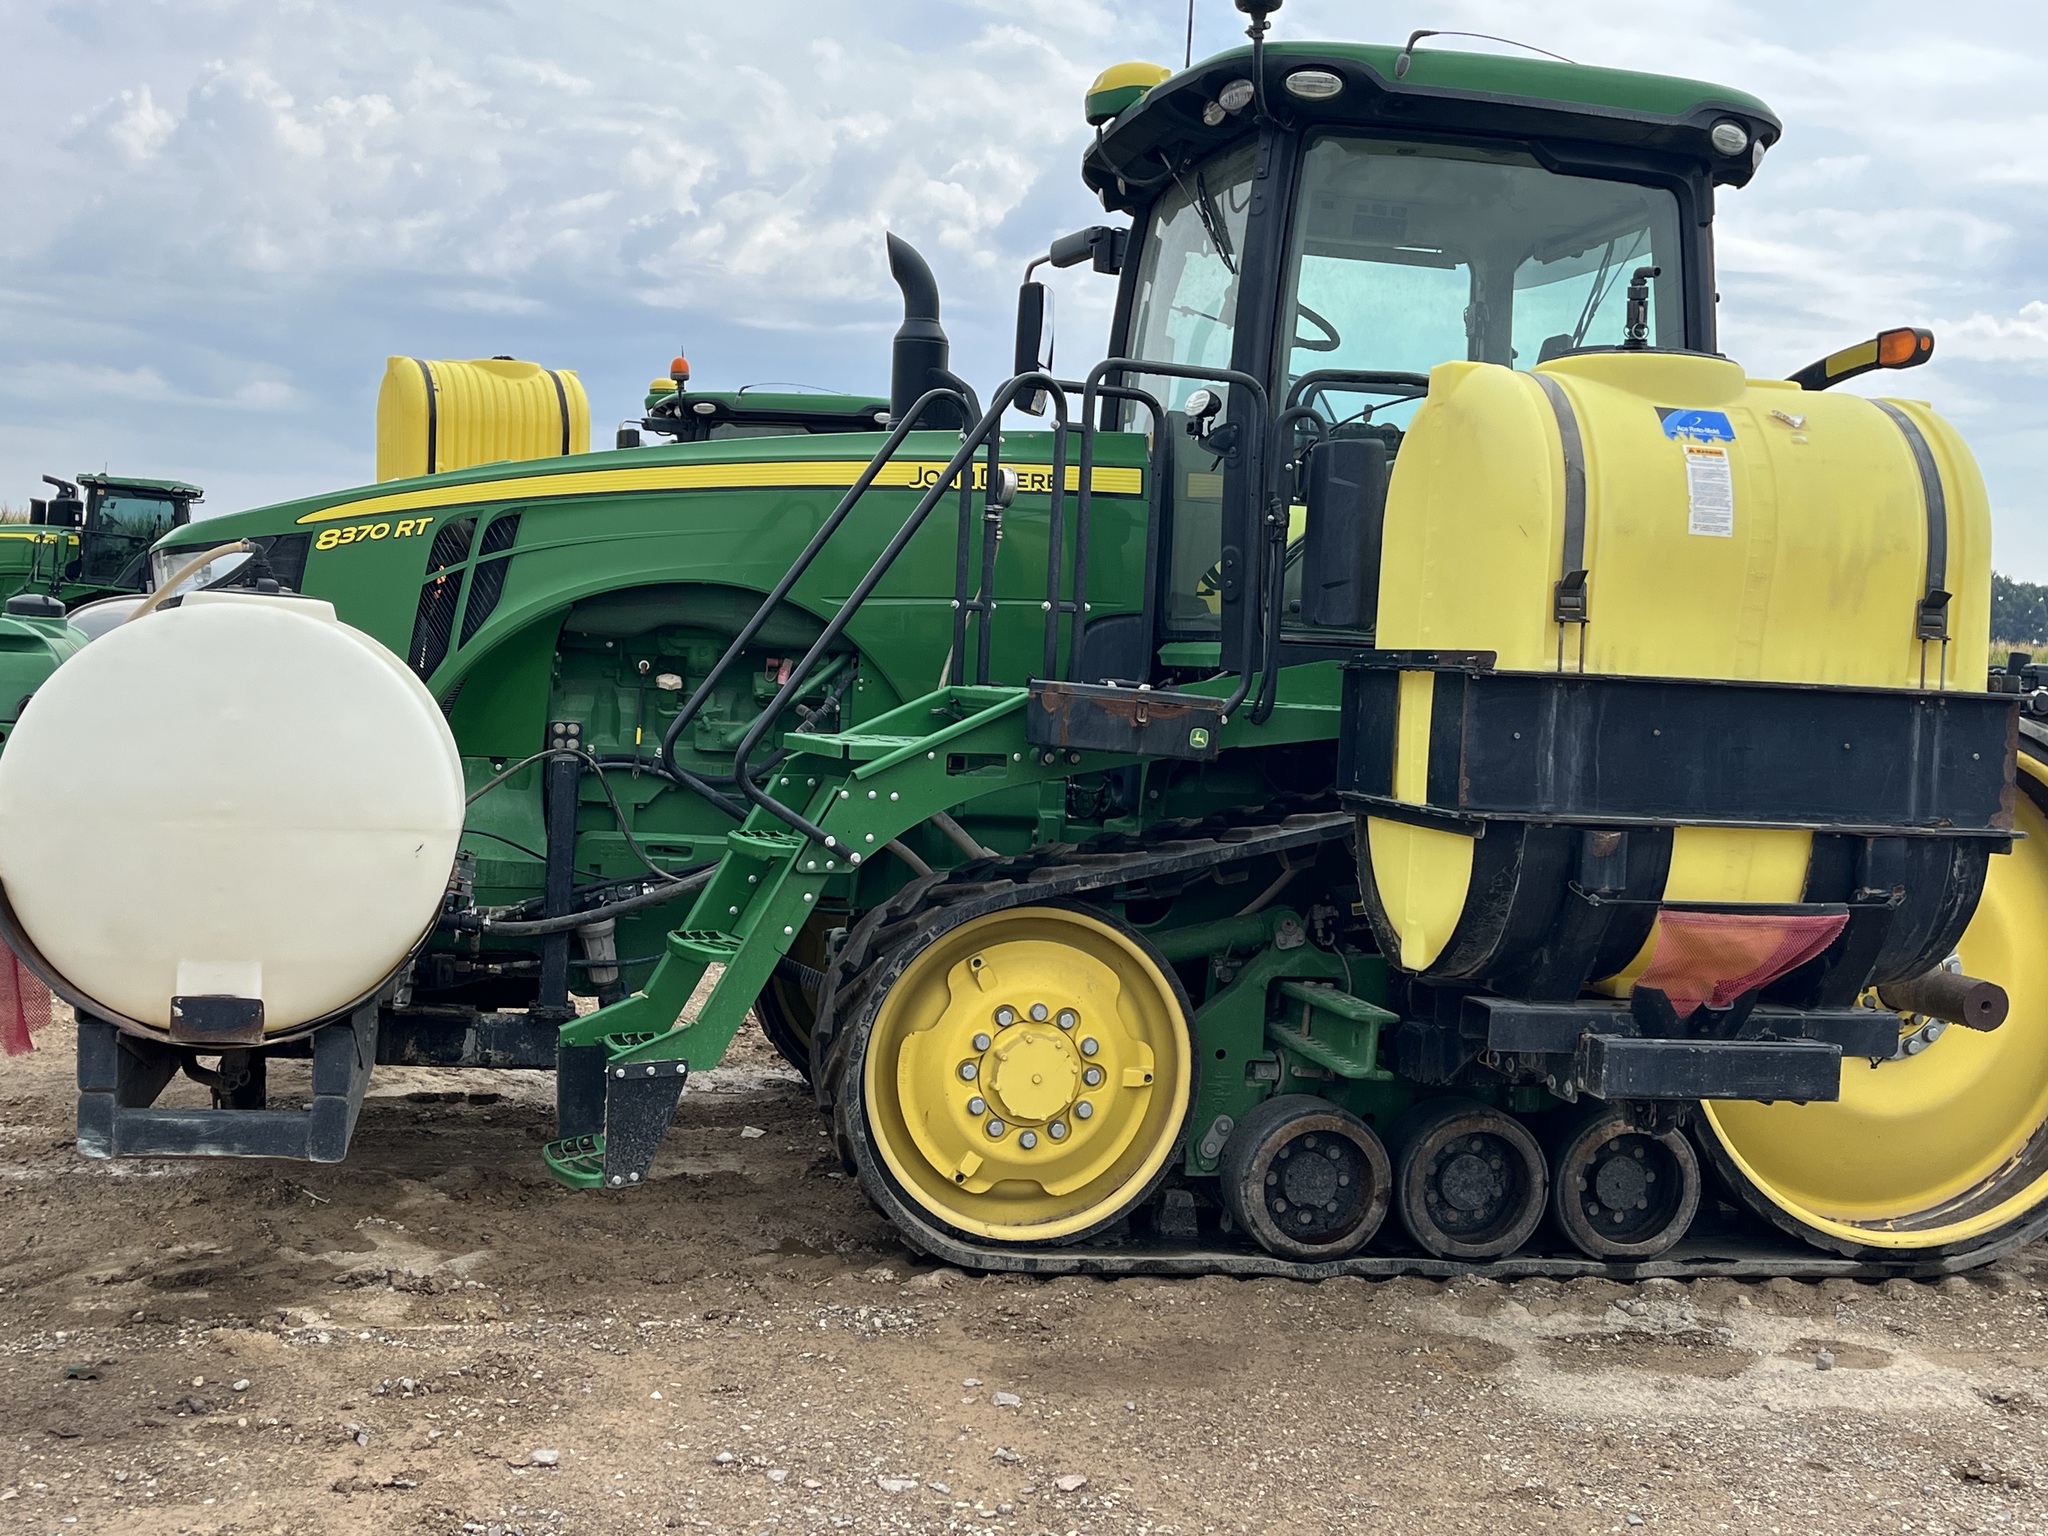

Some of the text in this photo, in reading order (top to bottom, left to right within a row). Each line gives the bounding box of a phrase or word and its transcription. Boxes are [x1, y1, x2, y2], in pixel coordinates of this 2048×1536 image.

[909, 466, 975, 486] JO
[315, 517, 435, 550] 8370 RT
